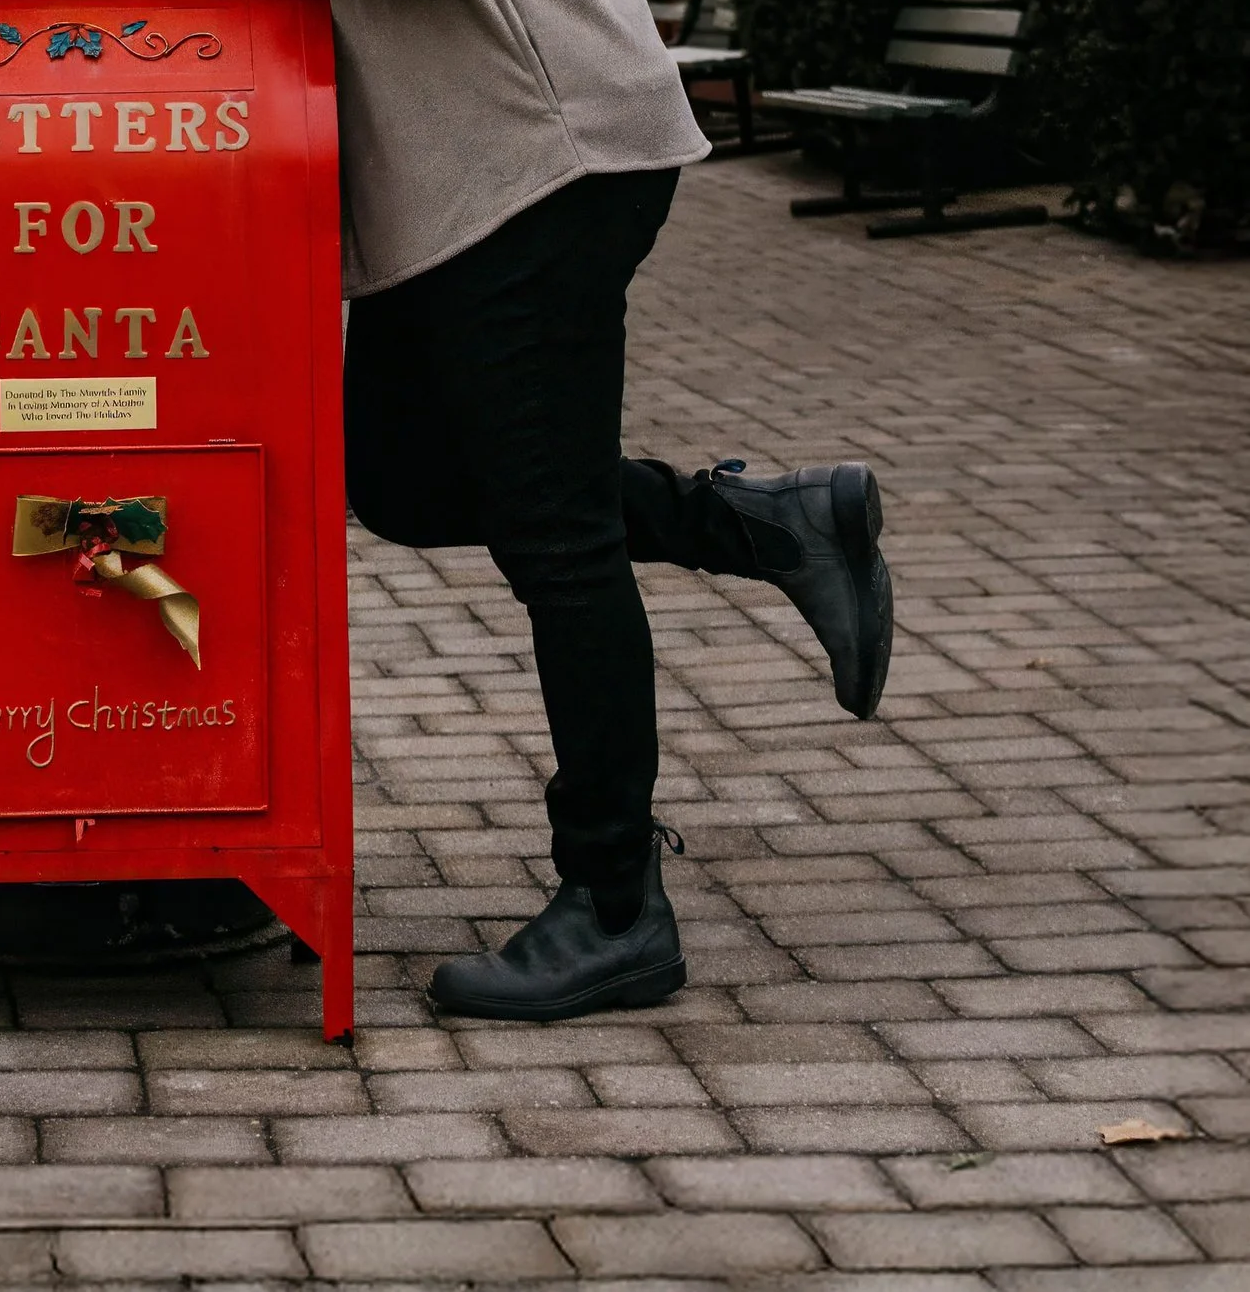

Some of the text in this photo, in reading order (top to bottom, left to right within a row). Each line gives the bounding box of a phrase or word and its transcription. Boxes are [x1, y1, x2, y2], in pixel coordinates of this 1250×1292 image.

[13, 200, 159, 255] FOR
[5, 389, 44, 399] Donated
[46, 389, 57, 399] By
[60, 389, 77, 398] The
[119, 387, 147, 397] Family
[8, 398, 145, 411] In Loving Memory of A Mother
[21, 409, 132, 421] Who Loved The Holidays
